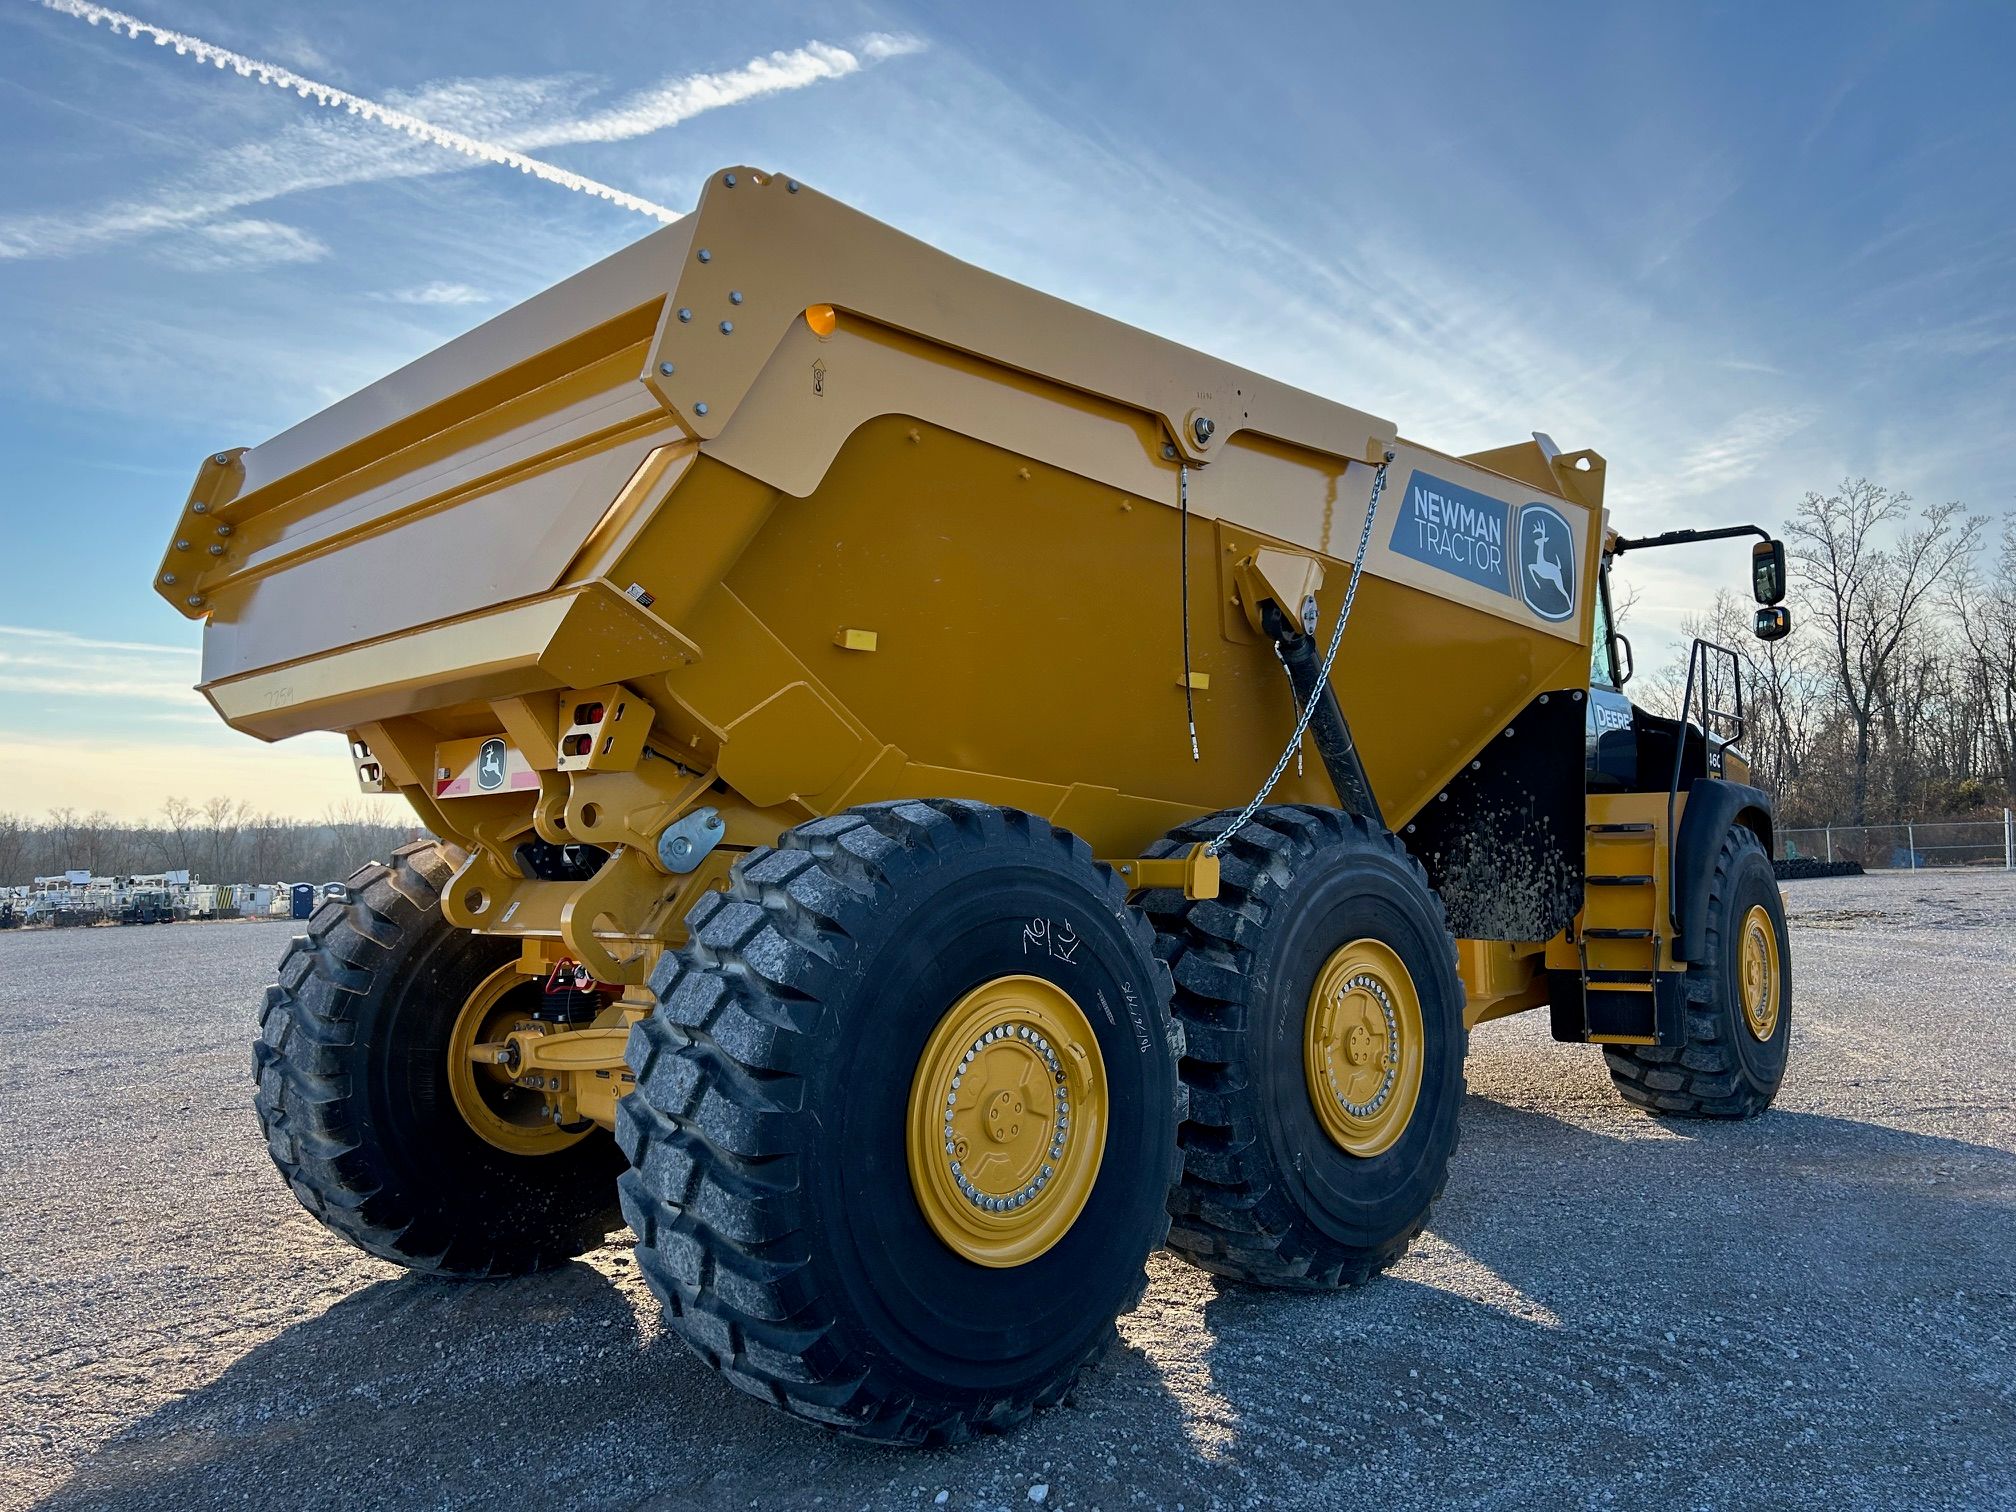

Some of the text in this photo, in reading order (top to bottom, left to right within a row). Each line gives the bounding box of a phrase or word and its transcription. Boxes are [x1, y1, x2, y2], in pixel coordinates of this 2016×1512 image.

[1414, 486, 1501, 545] NEWMAN
[1414, 518, 1502, 575] TRACTOR
[1596, 704, 1631, 731] DEERE
